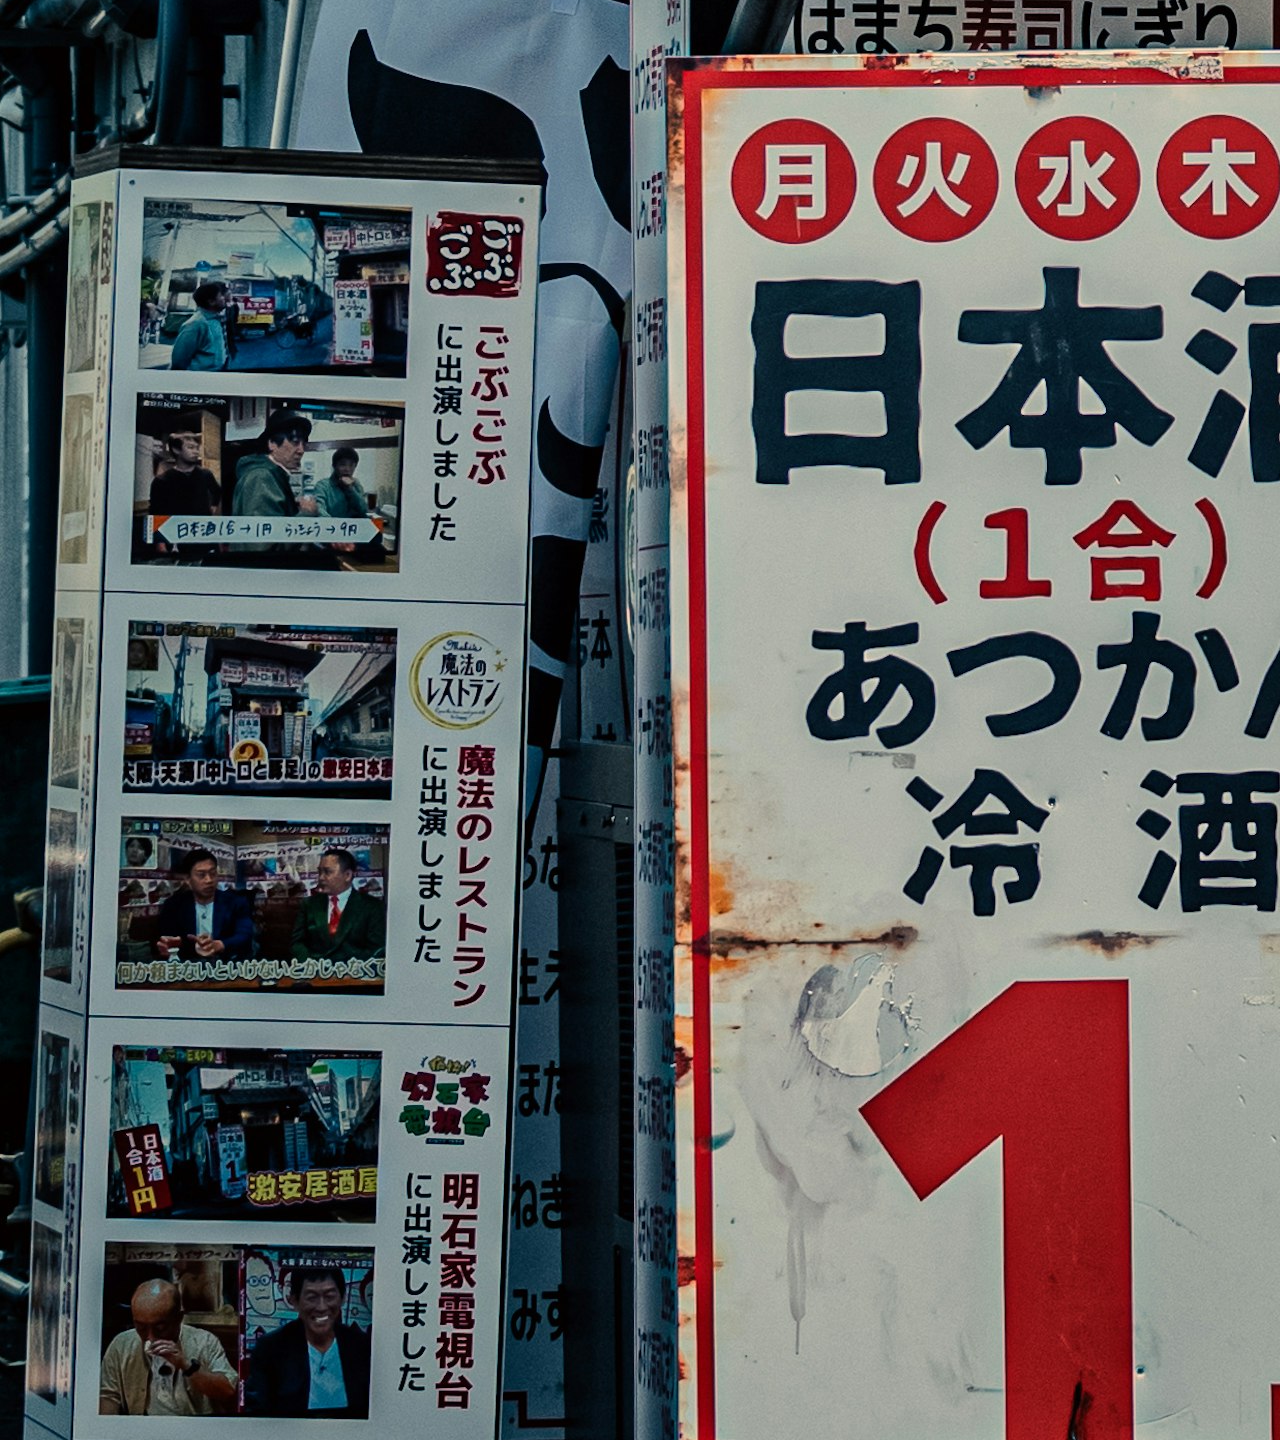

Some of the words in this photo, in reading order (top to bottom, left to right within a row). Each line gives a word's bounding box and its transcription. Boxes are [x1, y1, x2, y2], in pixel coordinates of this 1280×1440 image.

[429, 323, 465, 544] に出演しました
[467, 325, 512, 486] ごぶごぶ
[427, 677, 501, 708] レストラン
[413, 743, 449, 965] に出演しました
[451, 743, 497, 1009] 魔法のレストラン
[247, 1165, 378, 1204] 激安居酒屋
[397, 1171, 434, 1393] に出演しました
[434, 1171, 481, 1412] 明石家電視台
